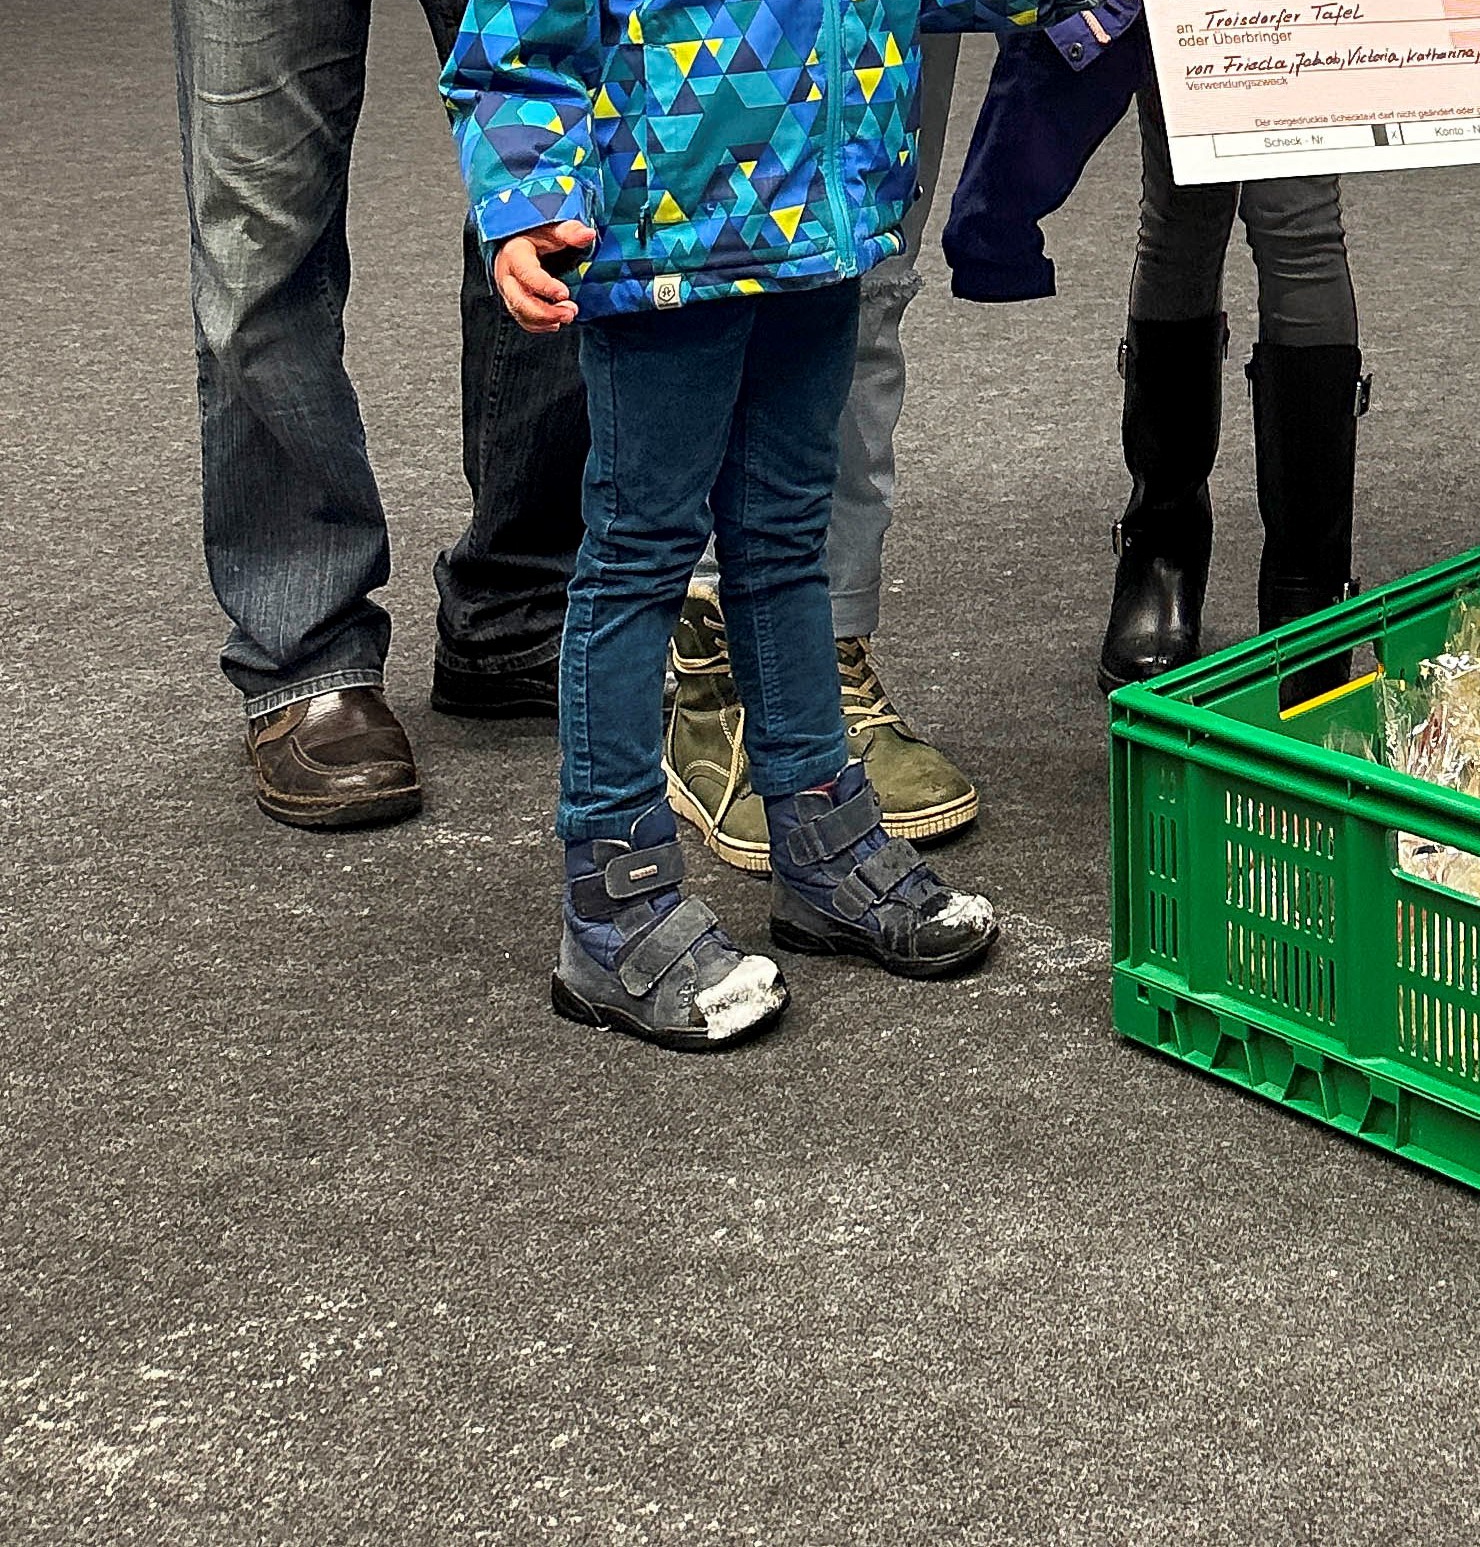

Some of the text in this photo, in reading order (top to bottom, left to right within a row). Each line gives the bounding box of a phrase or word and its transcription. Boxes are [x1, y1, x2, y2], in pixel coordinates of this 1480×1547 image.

[1205, 2, 1365, 31] Troisdorfer Tafel
[1176, 23, 1193, 34] an
[1178, 30, 1293, 47] oder Überbringer
[1186, 63, 1214, 76] von
[1185, 76, 1289, 91] Verwendungszweck
[1396, 109, 1417, 119] nicht
[1455, 106, 1475, 116] oder
[1435, 126, 1464, 137] Konto
[1263, 136, 1303, 148] Scheck
